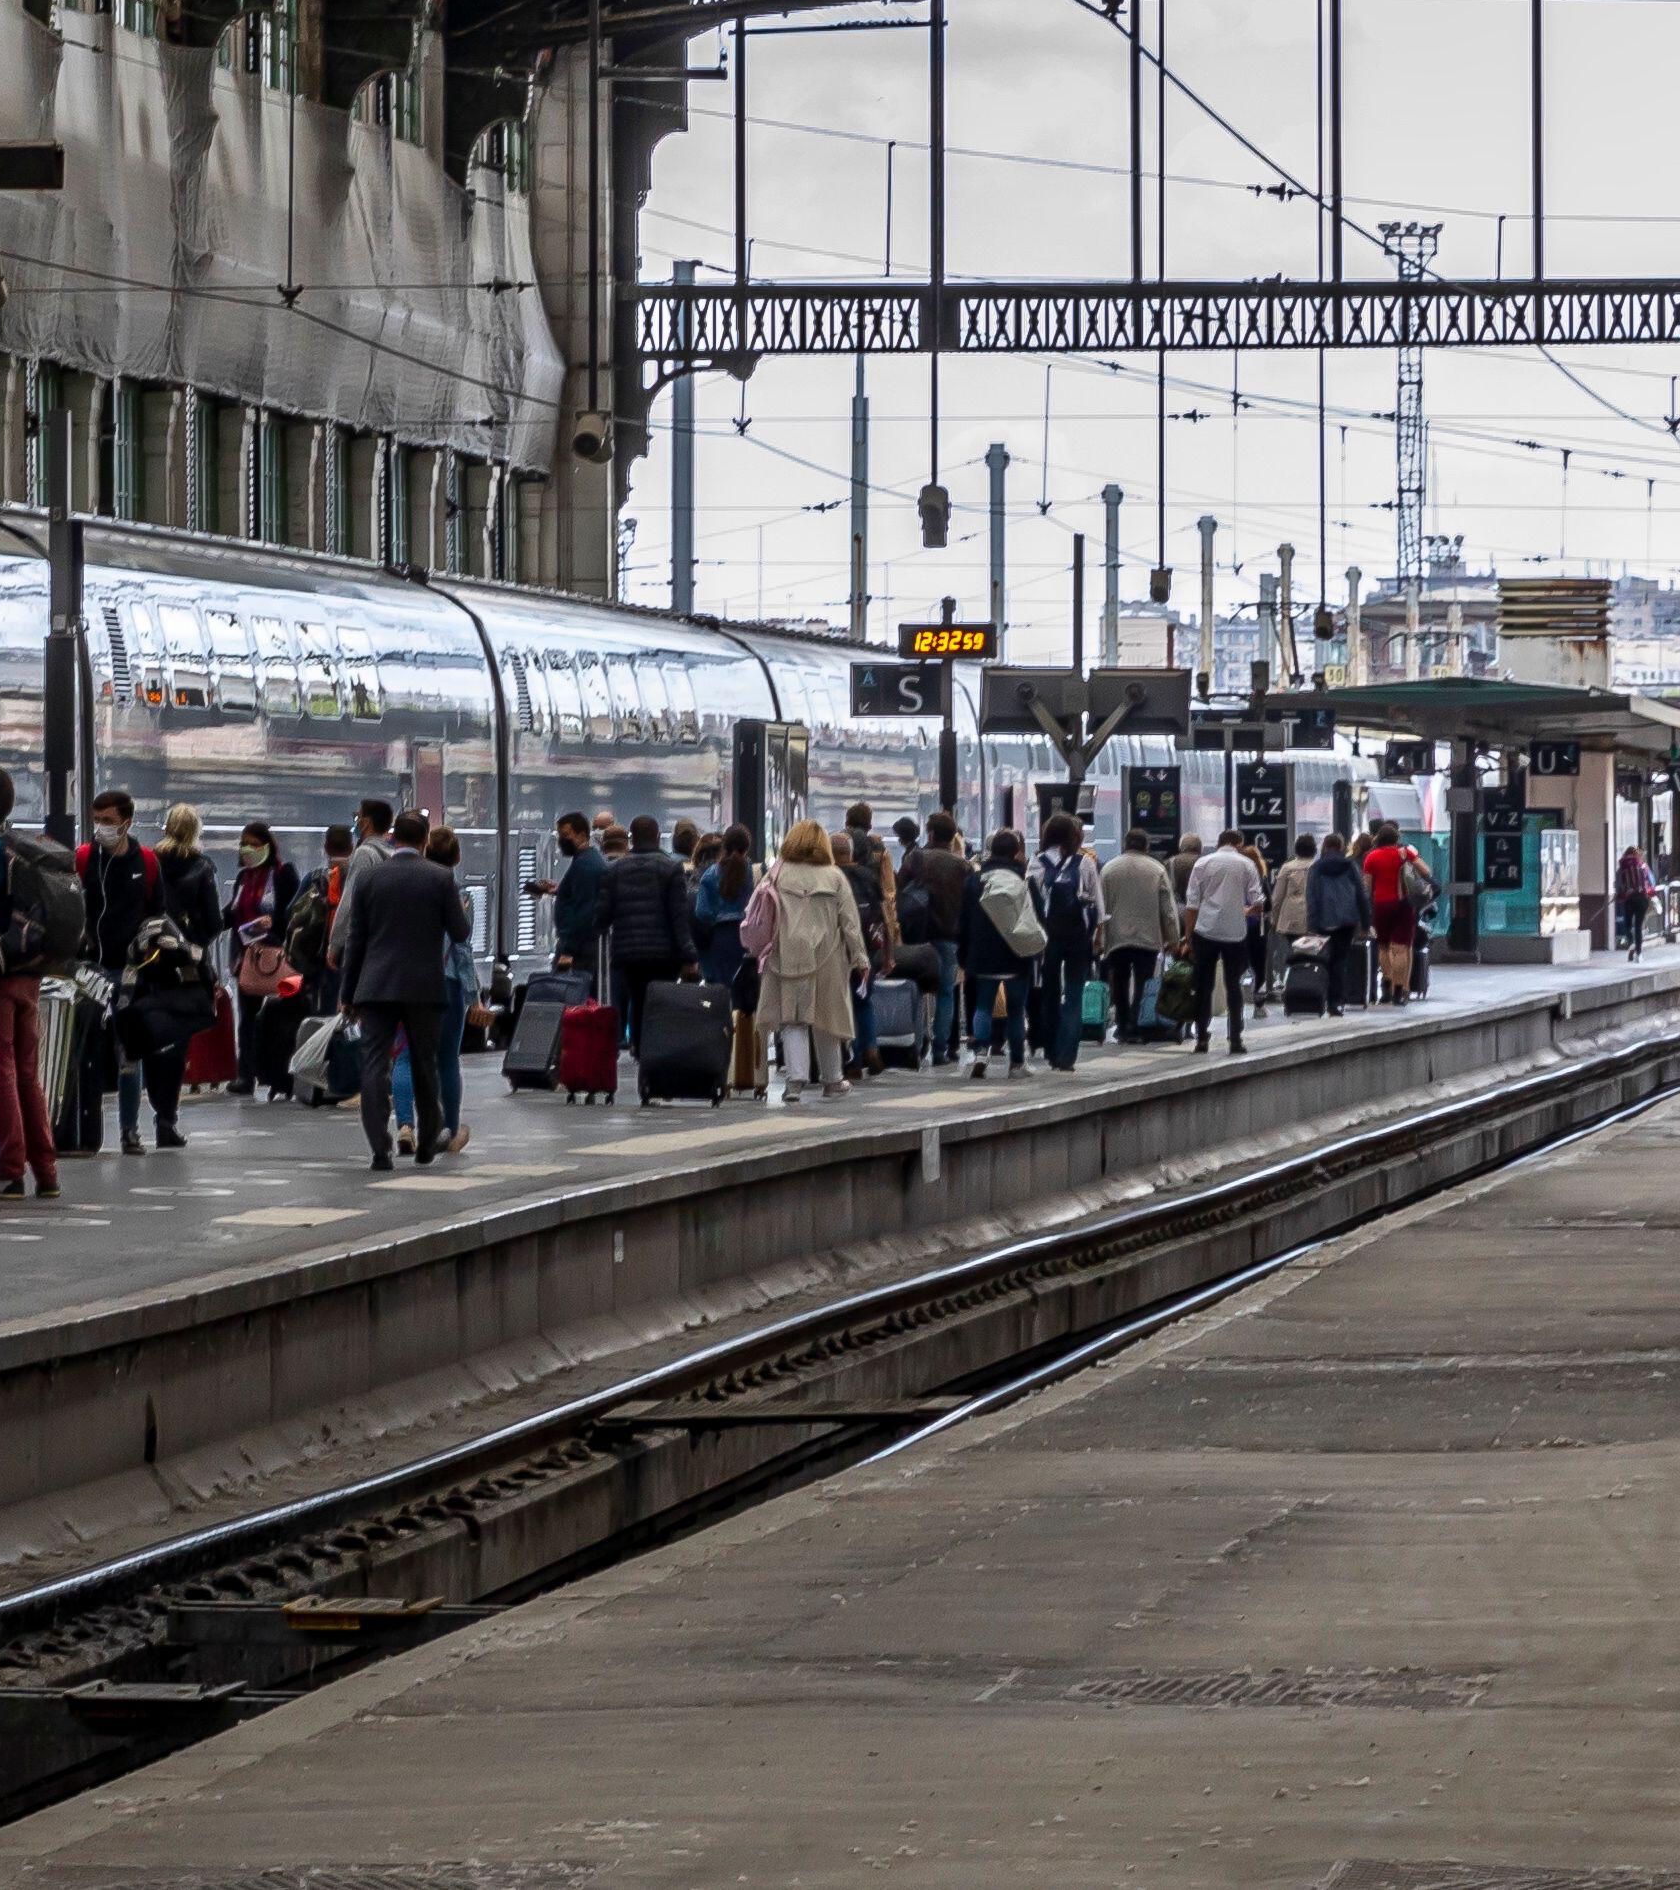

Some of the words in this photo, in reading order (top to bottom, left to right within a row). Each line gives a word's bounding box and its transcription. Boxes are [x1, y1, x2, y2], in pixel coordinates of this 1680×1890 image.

[897, 674, 924, 713] S
[1280, 718, 1301, 747] T
[1538, 750, 1556, 774] U
[1241, 797, 1256, 816] U
[1268, 797, 1283, 816] Z
